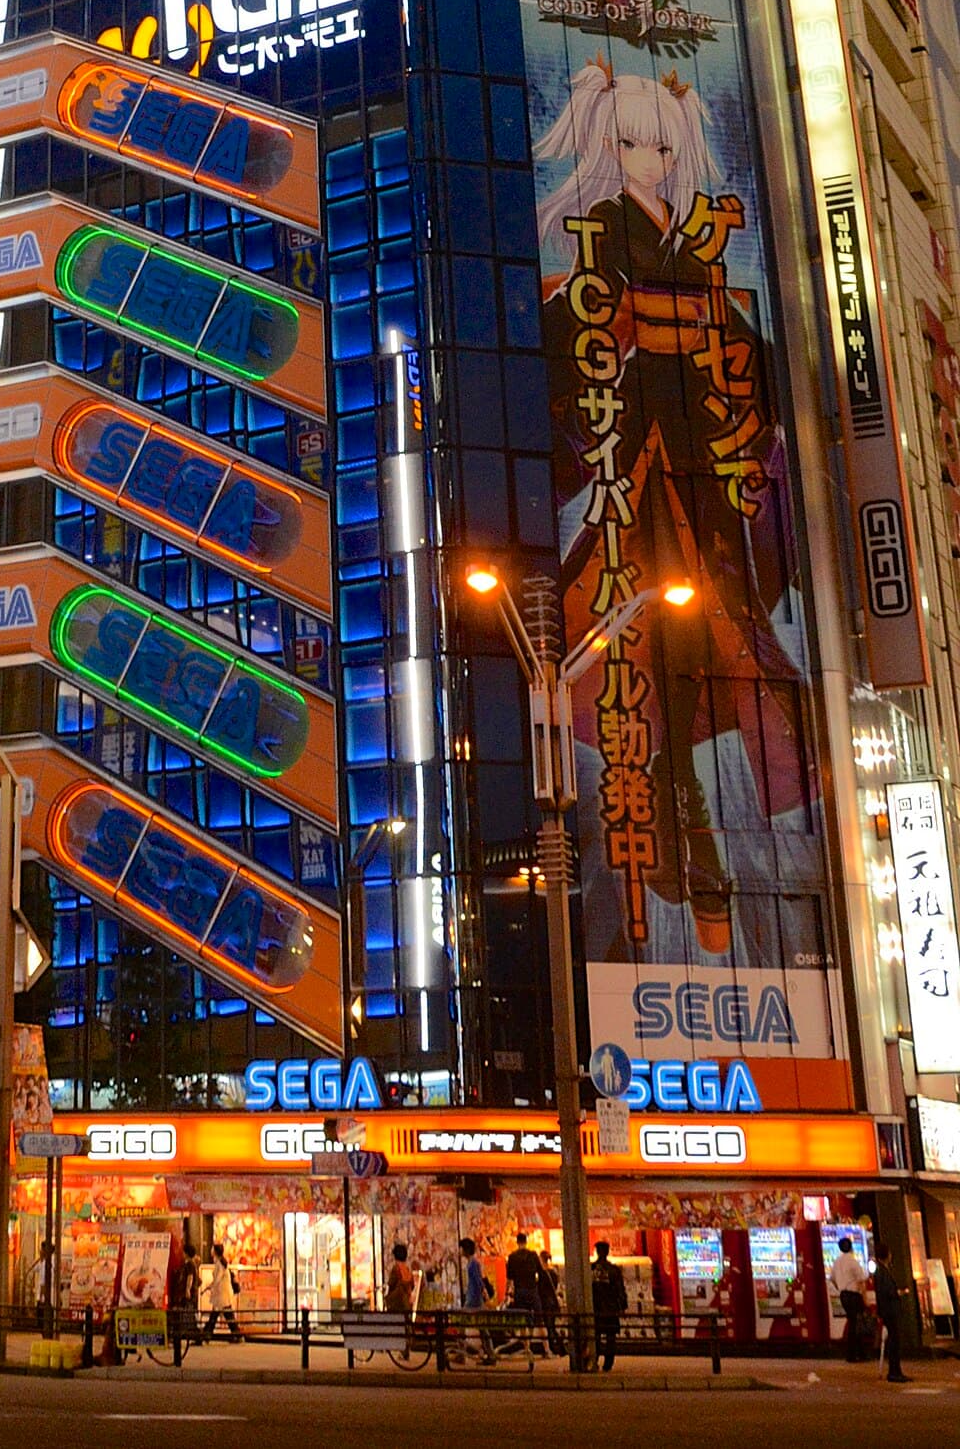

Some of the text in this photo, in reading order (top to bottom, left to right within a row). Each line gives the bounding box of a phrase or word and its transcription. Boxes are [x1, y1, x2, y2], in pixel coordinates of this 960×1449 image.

[604, 0, 632, 23] OF
[89, 79, 250, 186] SEGA
[85, 243, 256, 363] SEGA
[681, 191, 769, 520] ゲーセンで
[86, 421, 257, 552] SEGA
[83, 608, 261, 760] SEGA
[80, 806, 265, 970] SEGA
[633, 982, 800, 1044] SEGA
[245, 1056, 383, 1111] SEGA
[619, 1058, 765, 1112] SEGA
